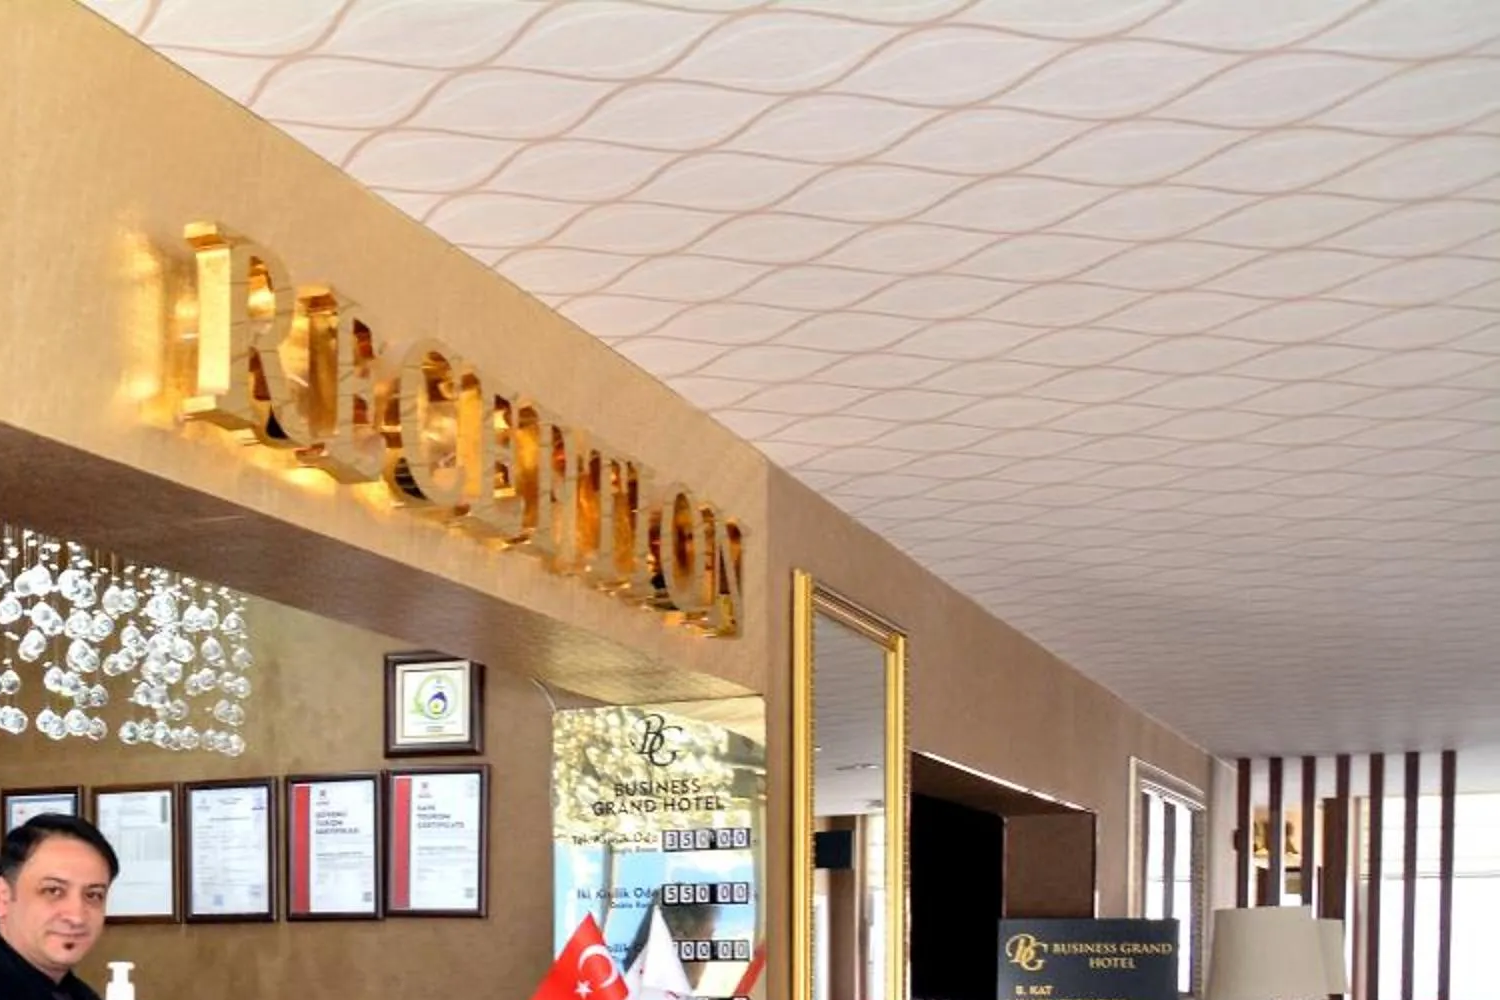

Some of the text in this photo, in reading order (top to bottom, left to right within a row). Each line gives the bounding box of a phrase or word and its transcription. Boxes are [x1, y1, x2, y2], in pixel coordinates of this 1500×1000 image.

[180, 220, 745, 638] RECEPTION
[613, 778, 701, 797] BUSINESS
[592, 796, 725, 816] GRAND HOTEL
[1052, 942, 1173, 955] BUSINESS GRAND
[1089, 957, 1136, 970] HOTEL
[1030, 985, 1053, 995] KAT
